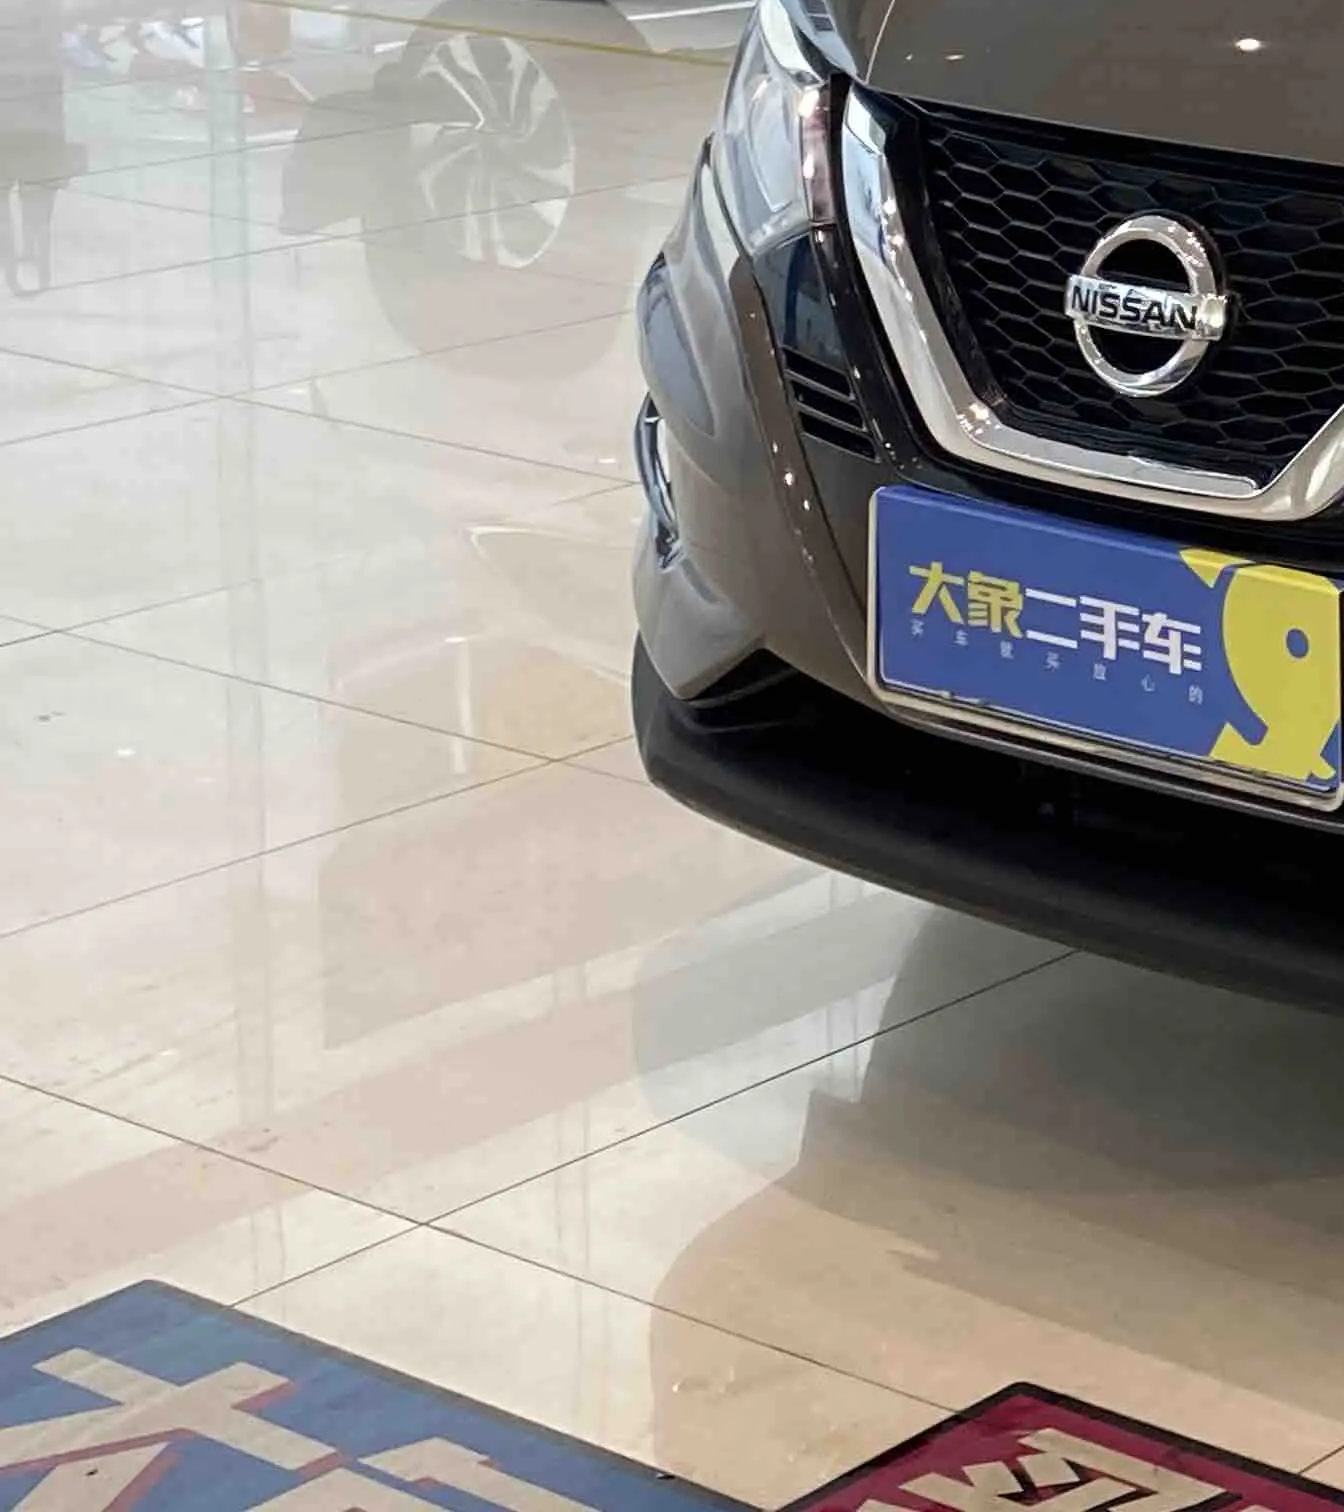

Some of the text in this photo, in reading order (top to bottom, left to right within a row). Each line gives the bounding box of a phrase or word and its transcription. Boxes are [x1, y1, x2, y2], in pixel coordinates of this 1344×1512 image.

[1071, 284, 1198, 331] NISSAN
[909, 561, 1202, 675] 大象二手车
